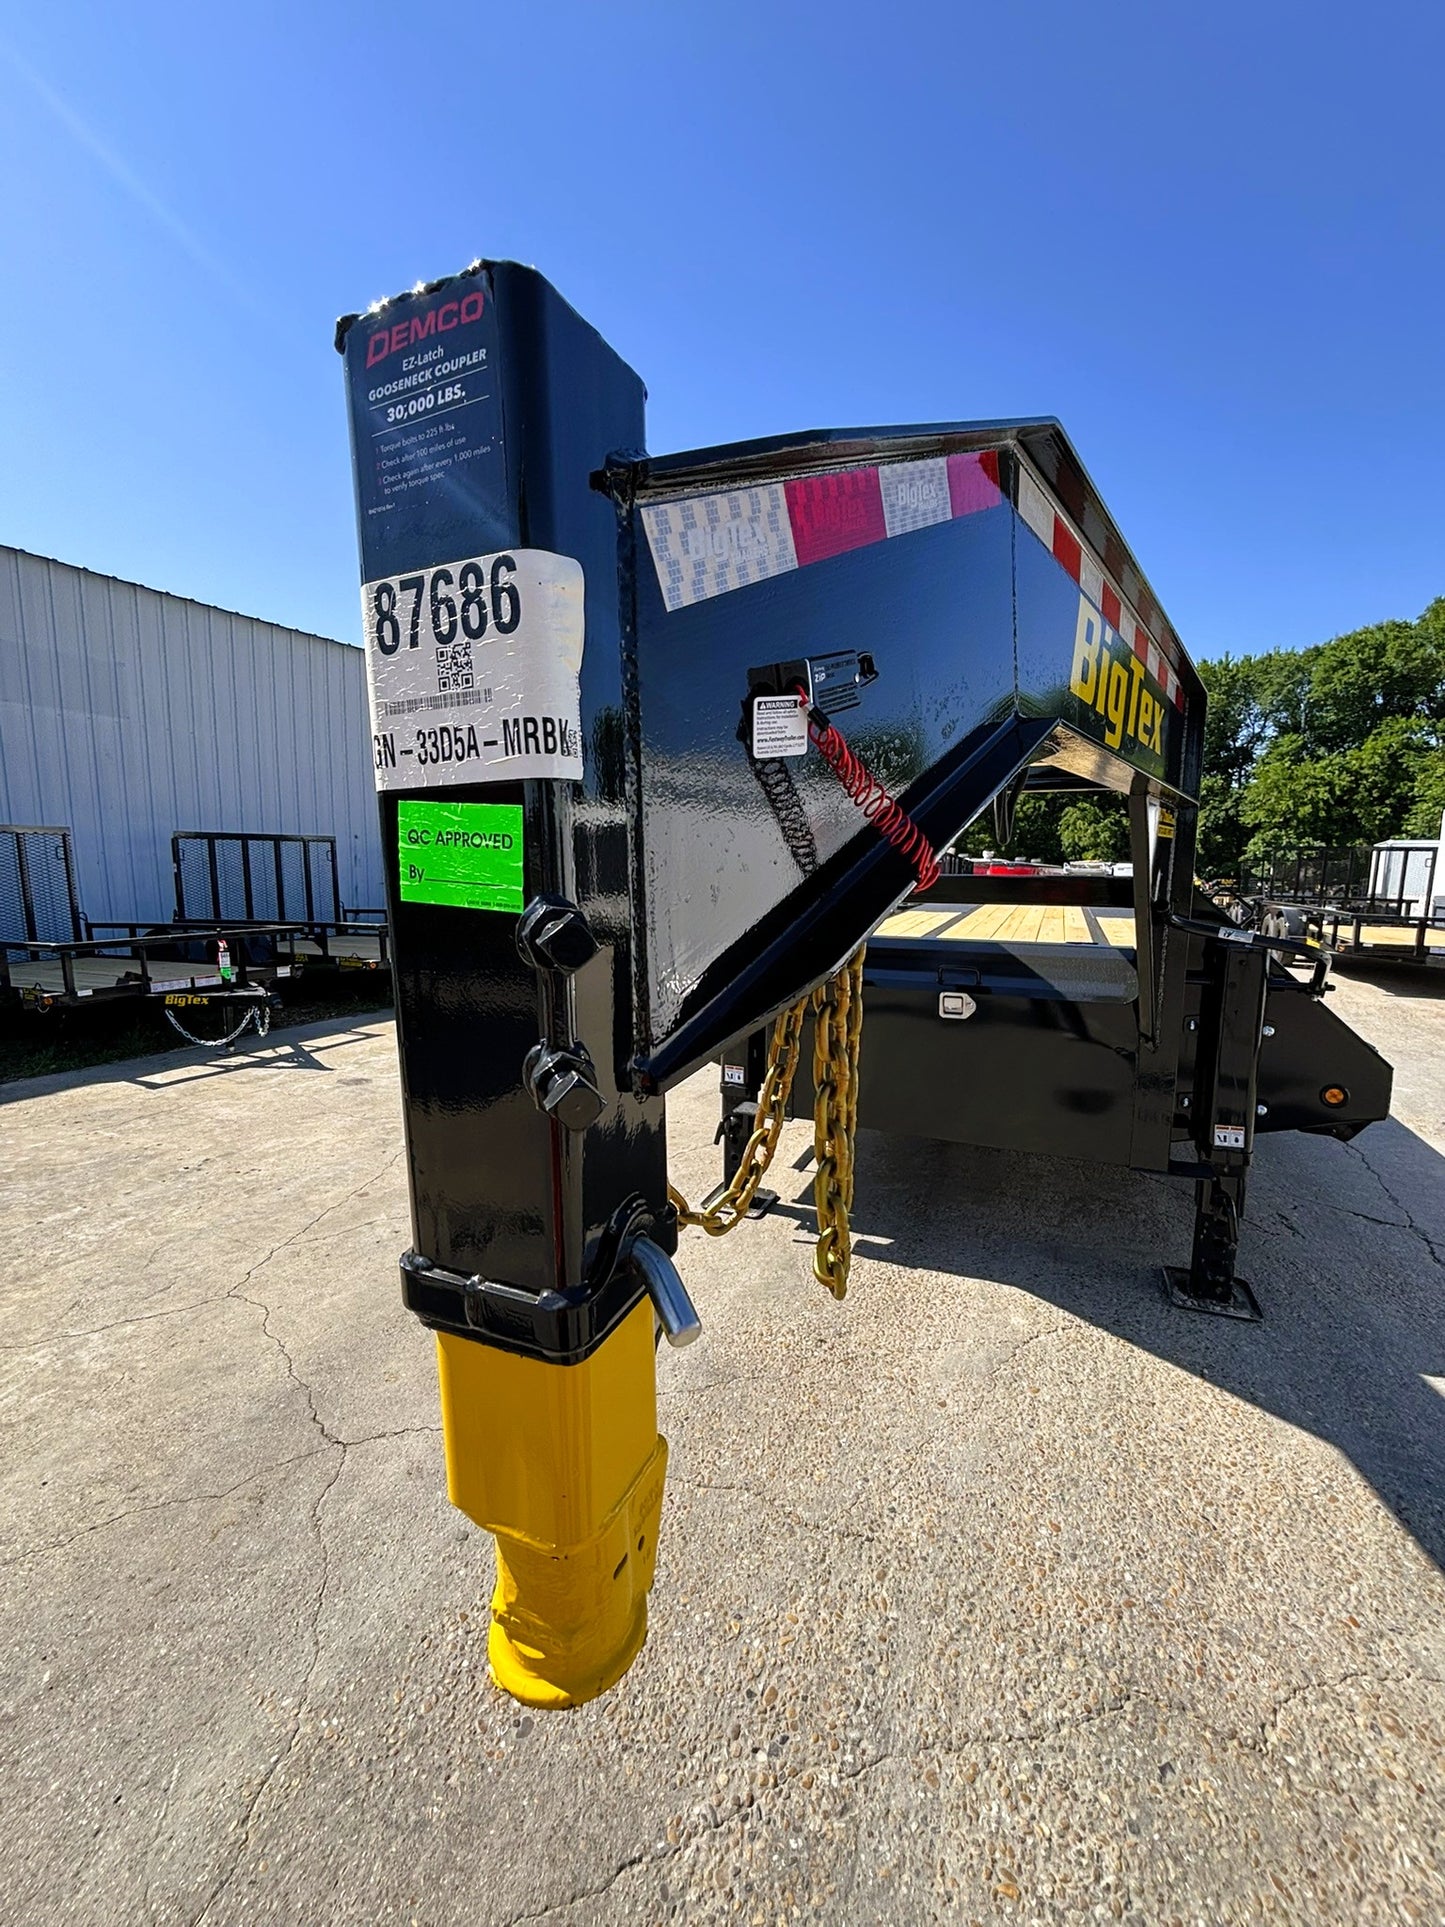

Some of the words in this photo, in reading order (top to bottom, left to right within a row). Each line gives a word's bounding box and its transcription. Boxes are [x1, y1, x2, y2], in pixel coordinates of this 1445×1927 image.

[366, 292, 485, 369] DEMCO
[402, 345, 444, 371] EZ-Latch
[368, 367, 433, 401] GOOSENECK
[434, 348, 487, 377] COUPLER
[387, 394, 434, 422] 30,000
[437, 384, 466, 405] LBS.
[380, 442, 401, 453] Torque
[402, 436, 418, 446] bolts
[418, 433, 426, 441] to
[426, 427, 438, 438] 225
[382, 457, 400, 469] Check
[402, 452, 416, 463] after
[417, 447, 428, 457] 100
[429, 443, 446, 454] miles
[446, 438, 454, 448] of
[454, 436, 466, 445] use
[383, 473, 402, 484] Check
[402, 468, 420, 479] again
[420, 463, 434, 473] after
[435, 458, 452, 468] every
[473, 445, 491, 456] miles
[392, 480, 408, 491] verify
[408, 475, 430, 487] torque
[897, 482, 936, 508] BigTex
[687, 519, 769, 562] BigTex
[374, 554, 521, 656] 87686
[1069, 592, 1165, 756] BigTex
[766, 701, 795, 709] WARNING
[407, 829, 432, 845] QC
[435, 830, 513, 849] APPROVED
[409, 864, 425, 883] By
[165, 994, 209, 1007] BigTex
